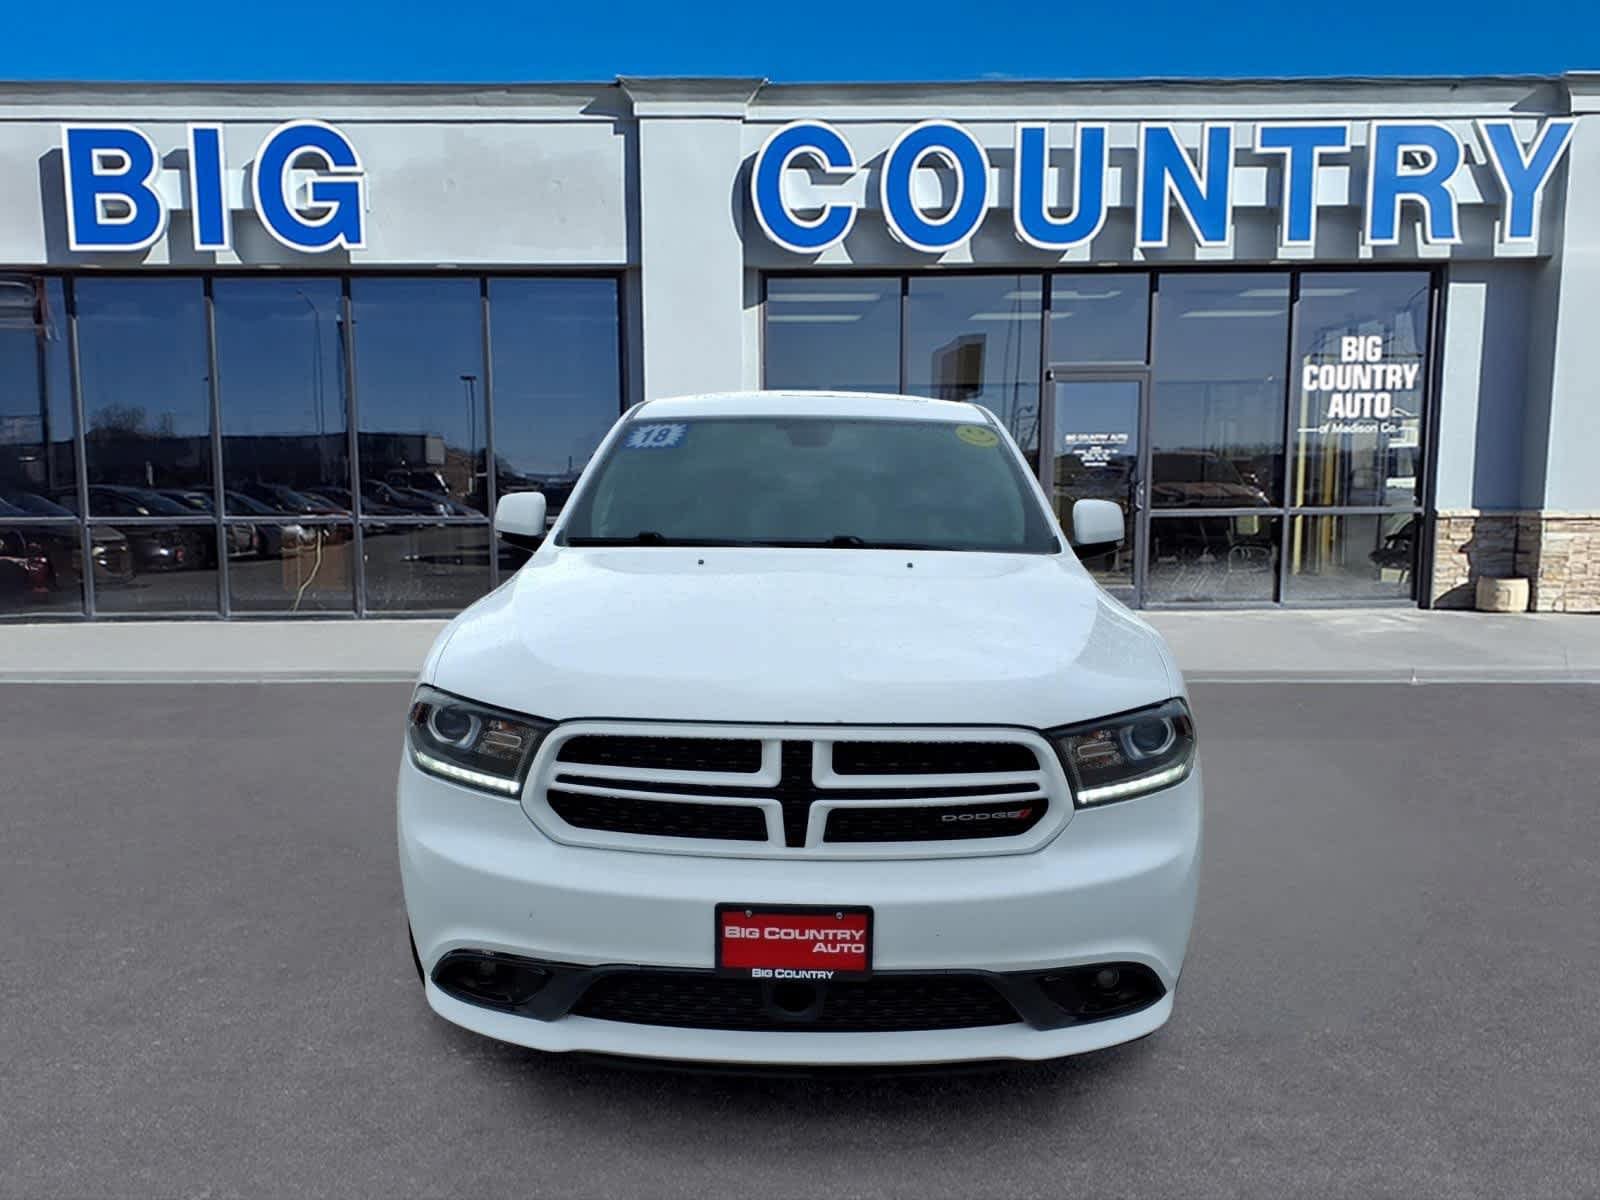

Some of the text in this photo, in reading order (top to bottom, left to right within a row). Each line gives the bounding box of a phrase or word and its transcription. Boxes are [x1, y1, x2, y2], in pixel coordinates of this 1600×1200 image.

[61, 119, 1577, 255] BIG COUNTRY
[1341, 336, 1383, 362] BIG
[1303, 363, 1420, 391] COUNTRY
[1328, 392, 1392, 419] AUTO
[942, 811, 1018, 822] DODGE
